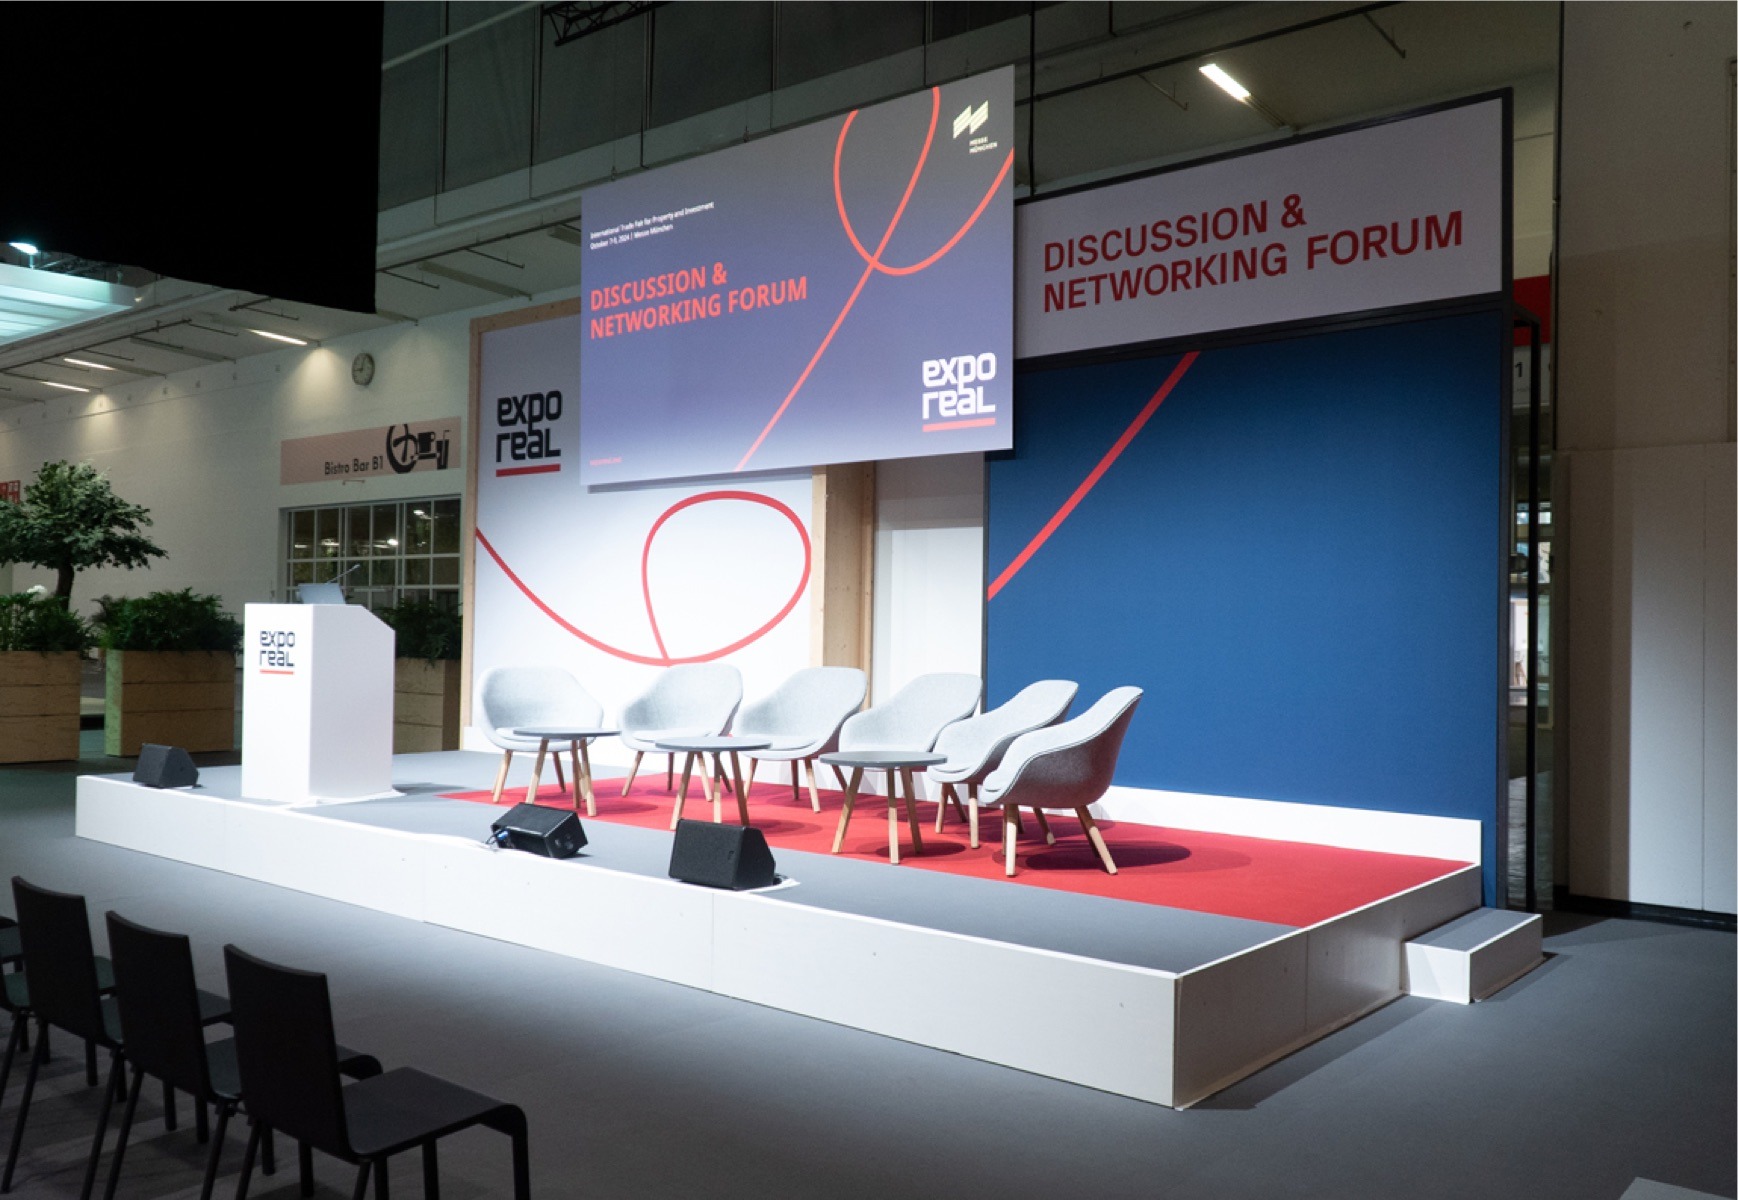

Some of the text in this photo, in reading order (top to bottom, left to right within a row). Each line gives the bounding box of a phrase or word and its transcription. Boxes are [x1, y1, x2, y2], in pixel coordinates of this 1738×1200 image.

[1044, 193, 1307, 273] DISCUSSION &
[1043, 210, 1462, 314] NETWORKING FORUM
[590, 261, 727, 311] DISCUSSION &
[590, 276, 807, 339] NETWORKING FORUM
[922, 352, 996, 392] expo
[497, 390, 562, 433] expo
[324, 455, 383, 475] Bistro Bar B1
[260, 630, 296, 650] expo
